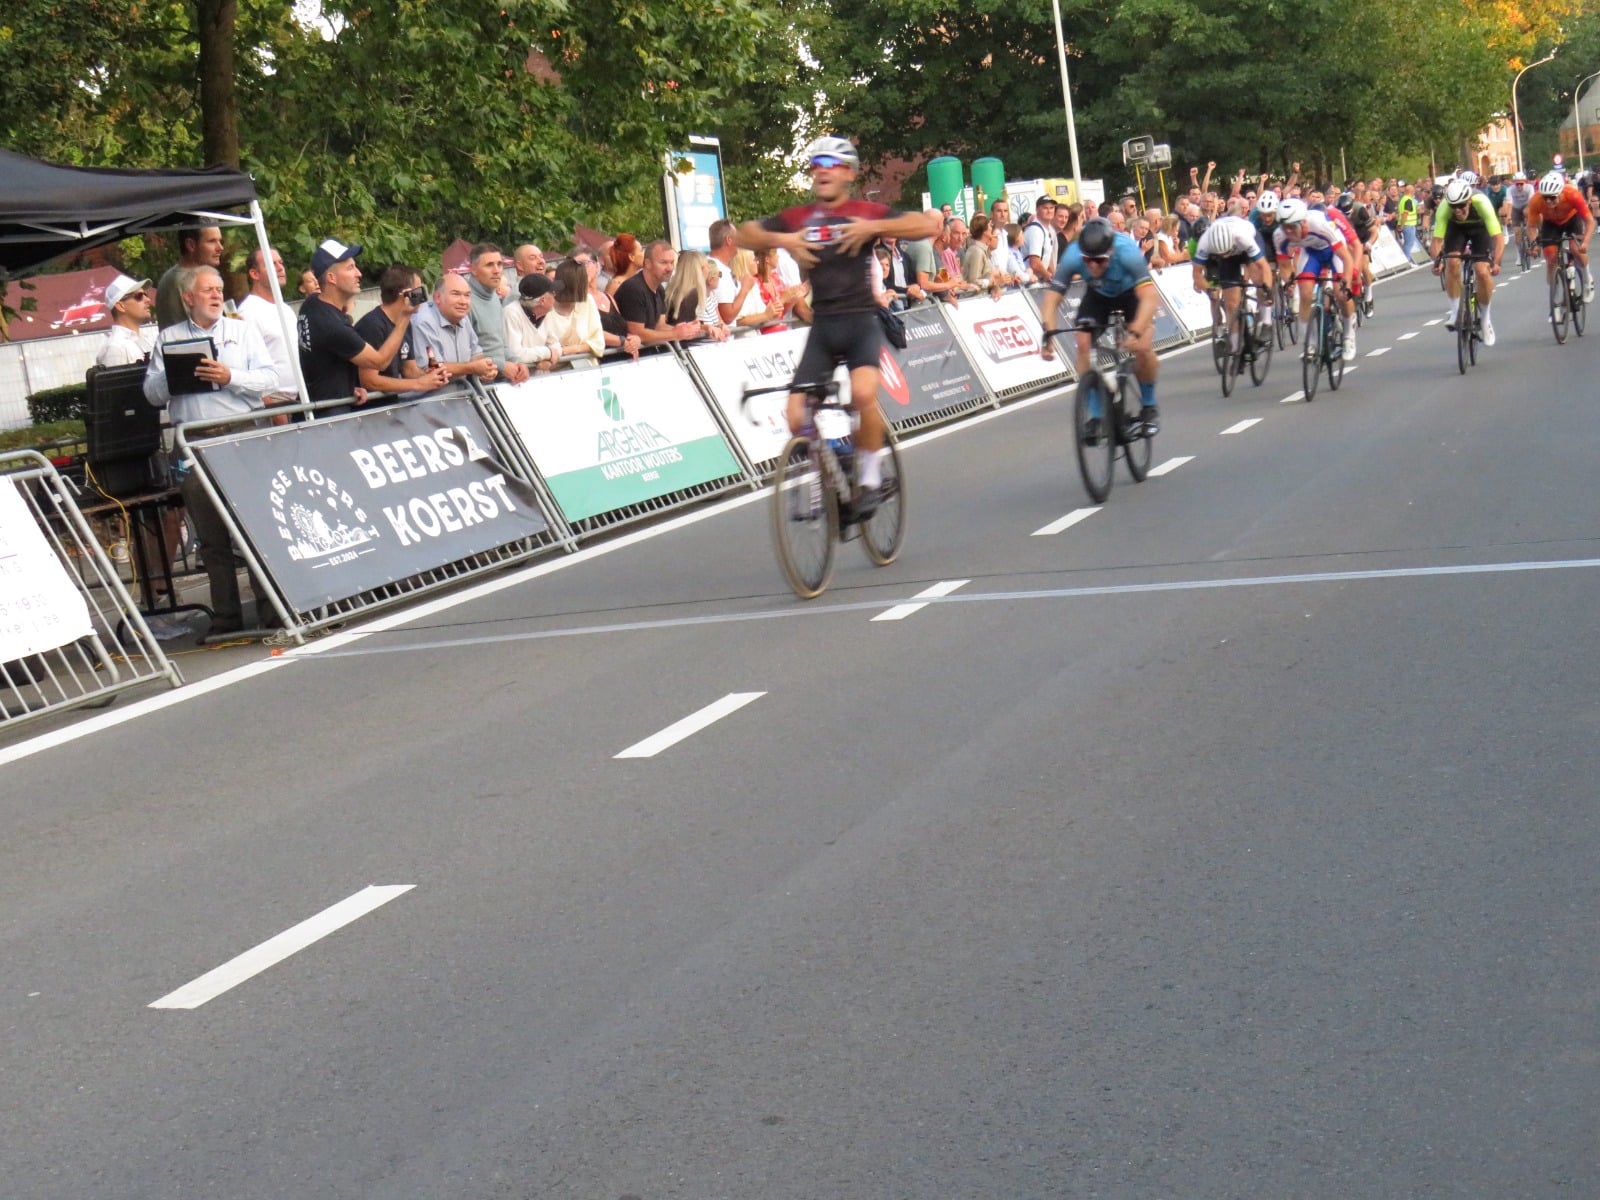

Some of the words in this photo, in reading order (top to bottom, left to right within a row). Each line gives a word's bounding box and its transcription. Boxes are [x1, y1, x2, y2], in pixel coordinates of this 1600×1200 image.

[598, 422, 672, 461] ARGENTA
[600, 456, 646, 480] KANTOOR
[641, 447, 684, 470] WOUTERS
[269, 469, 303, 561] BEERSE
[382, 434, 516, 546] KOERST
